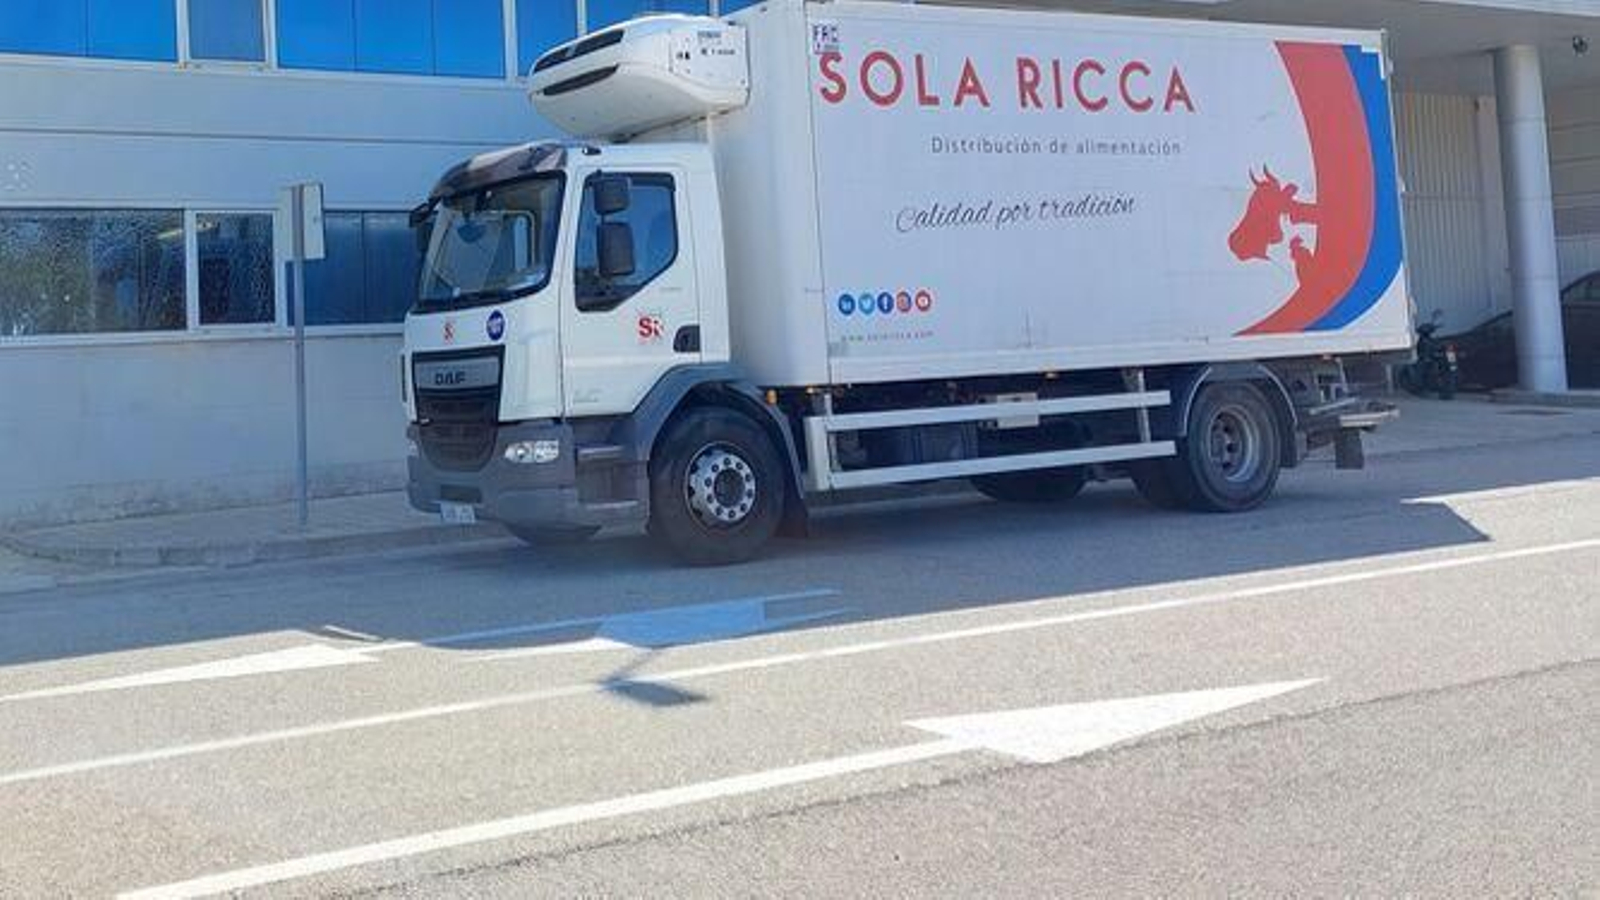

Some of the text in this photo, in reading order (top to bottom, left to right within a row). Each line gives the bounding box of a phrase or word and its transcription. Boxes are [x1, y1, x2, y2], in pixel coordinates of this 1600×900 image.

[819, 51, 1195, 112] SOLA RICCA
[931, 137, 1182, 155] Distribución de alimentación
[896, 200, 993, 233] Calidad
[996, 201, 1032, 230] por
[435, 371, 466, 386] DAF
